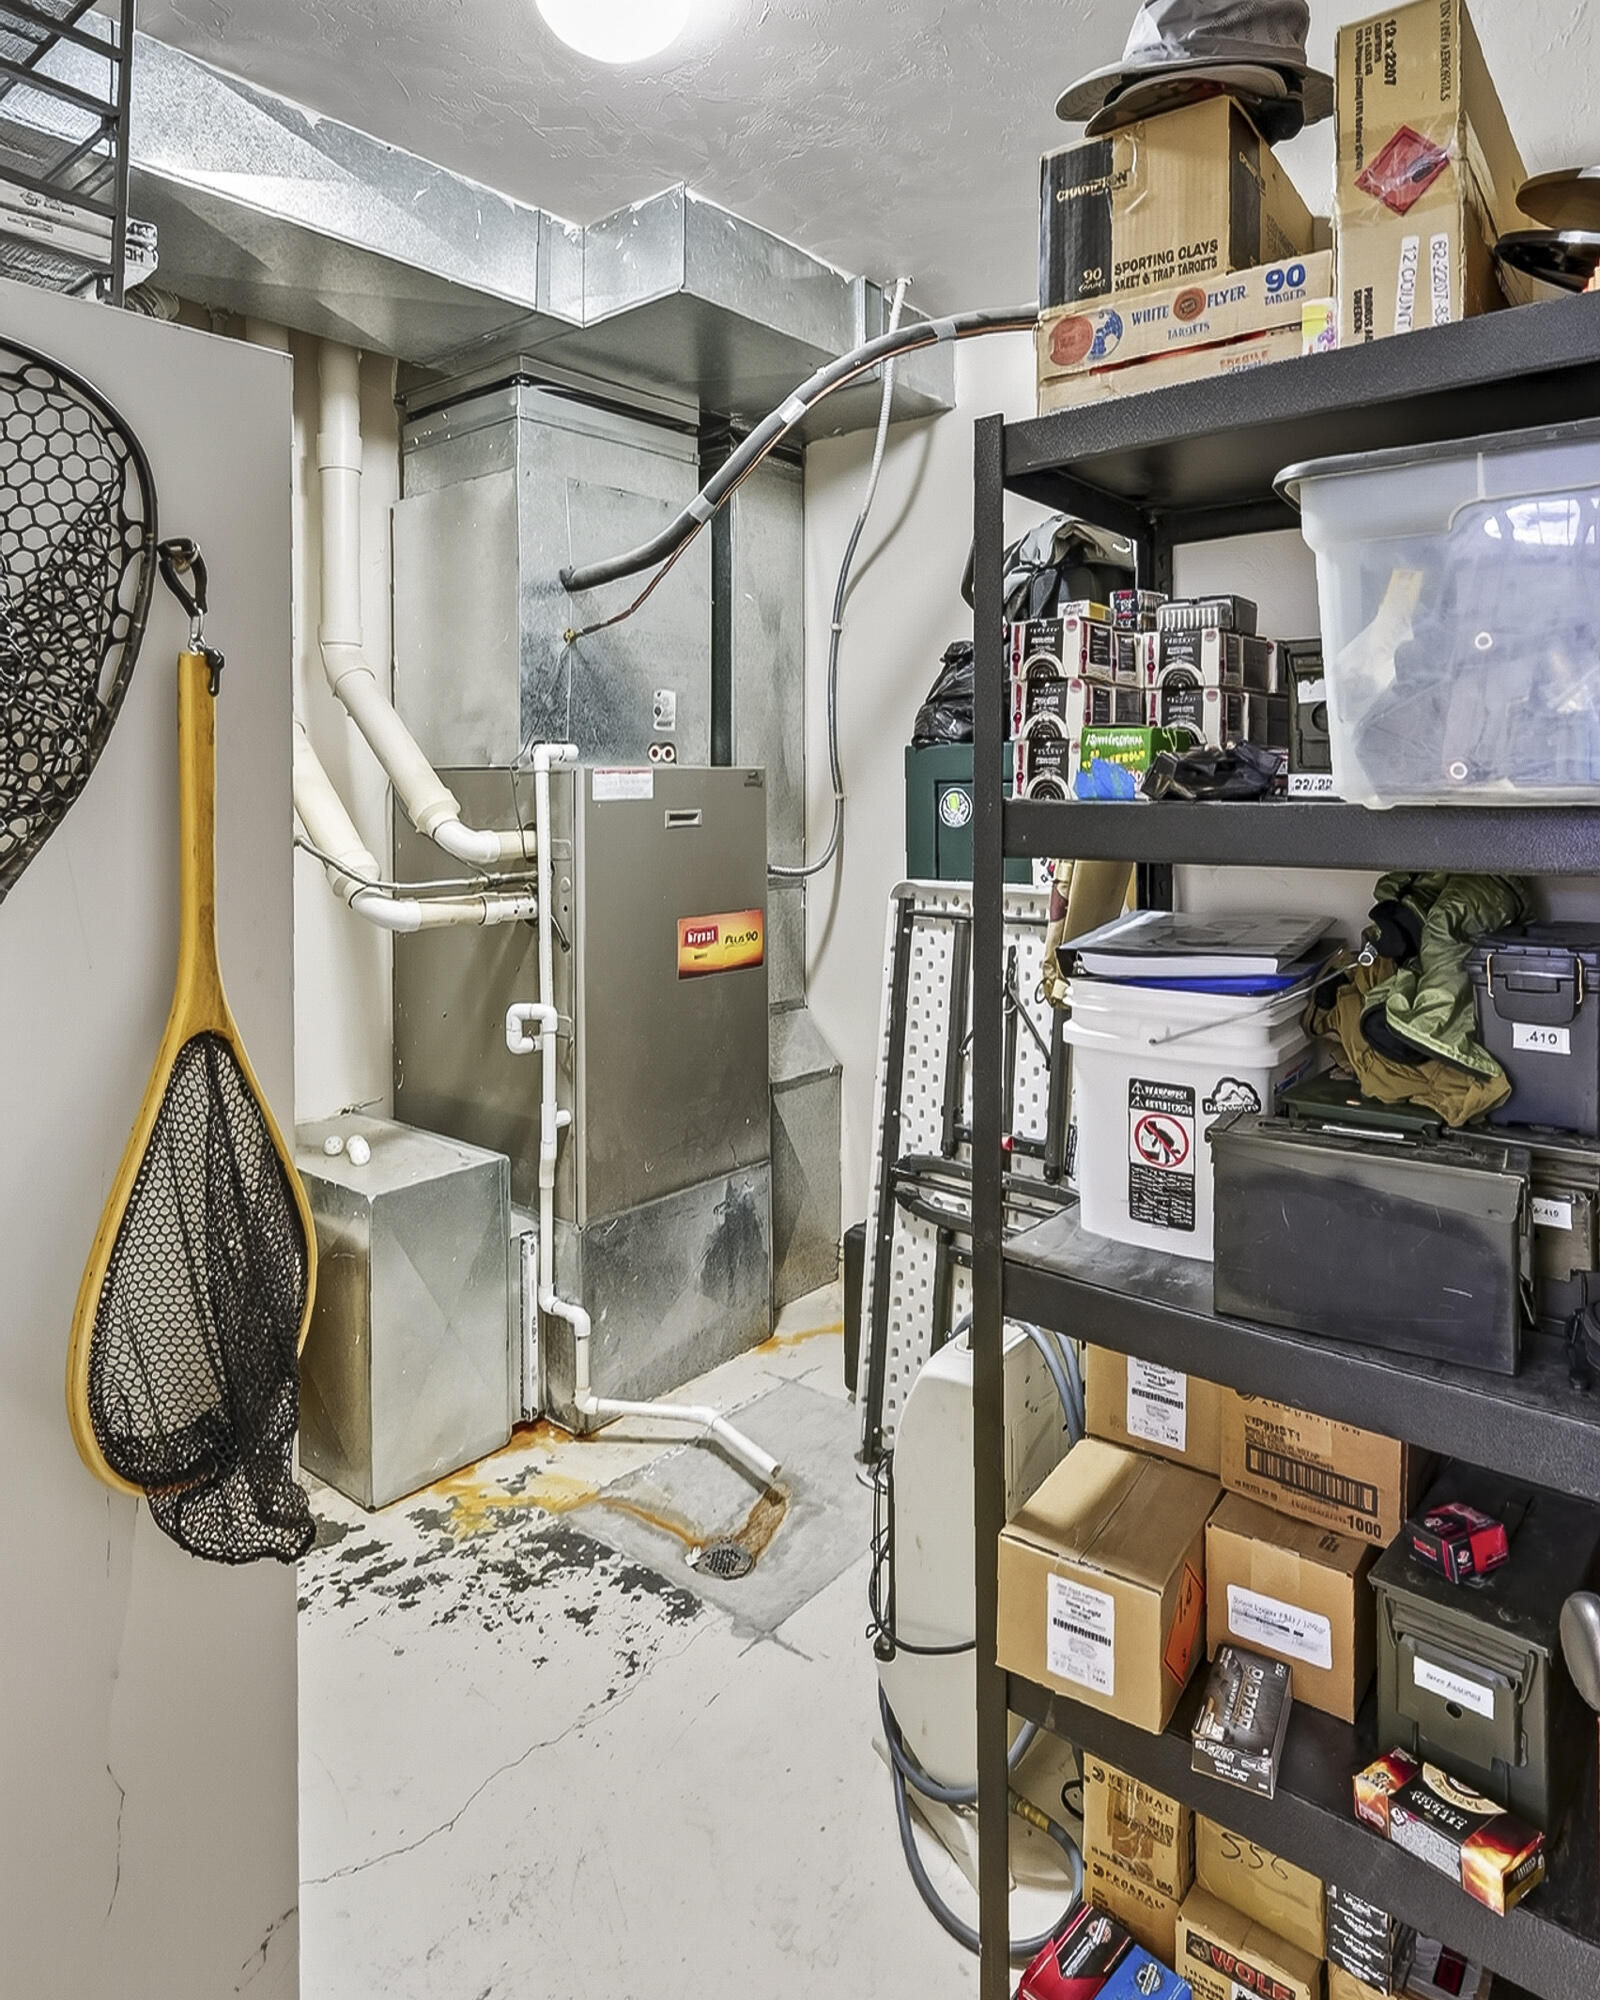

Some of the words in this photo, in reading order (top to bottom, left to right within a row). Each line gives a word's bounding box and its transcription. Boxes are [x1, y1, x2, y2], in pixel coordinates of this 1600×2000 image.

[1385, 19, 1397, 36] 12
[1384, 51, 1397, 86] 2207
[1114, 250, 1174, 277] SPORTING
[1178, 239, 1218, 260] CLAYS
[1403, 245, 1416, 264] 12
[1084, 267, 1102, 281] 90
[1114, 275, 1140, 292] SKEET
[1153, 265, 1176, 283] TRAP
[1178, 256, 1218, 276] TARGETS
[1265, 264, 1306, 293] 90
[1131, 304, 1169, 326] WHITE
[1207, 285, 1246, 308] FLYER
[1264, 289, 1306, 306] TARGETS
[1398, 268, 1415, 328] COUNT
[1167, 321, 1210, 341] TARGETS
[1526, 1031, 1558, 1045] .410
[1347, 1514, 1382, 1540] 1000
[1210, 1945, 1293, 2000] WOLF
